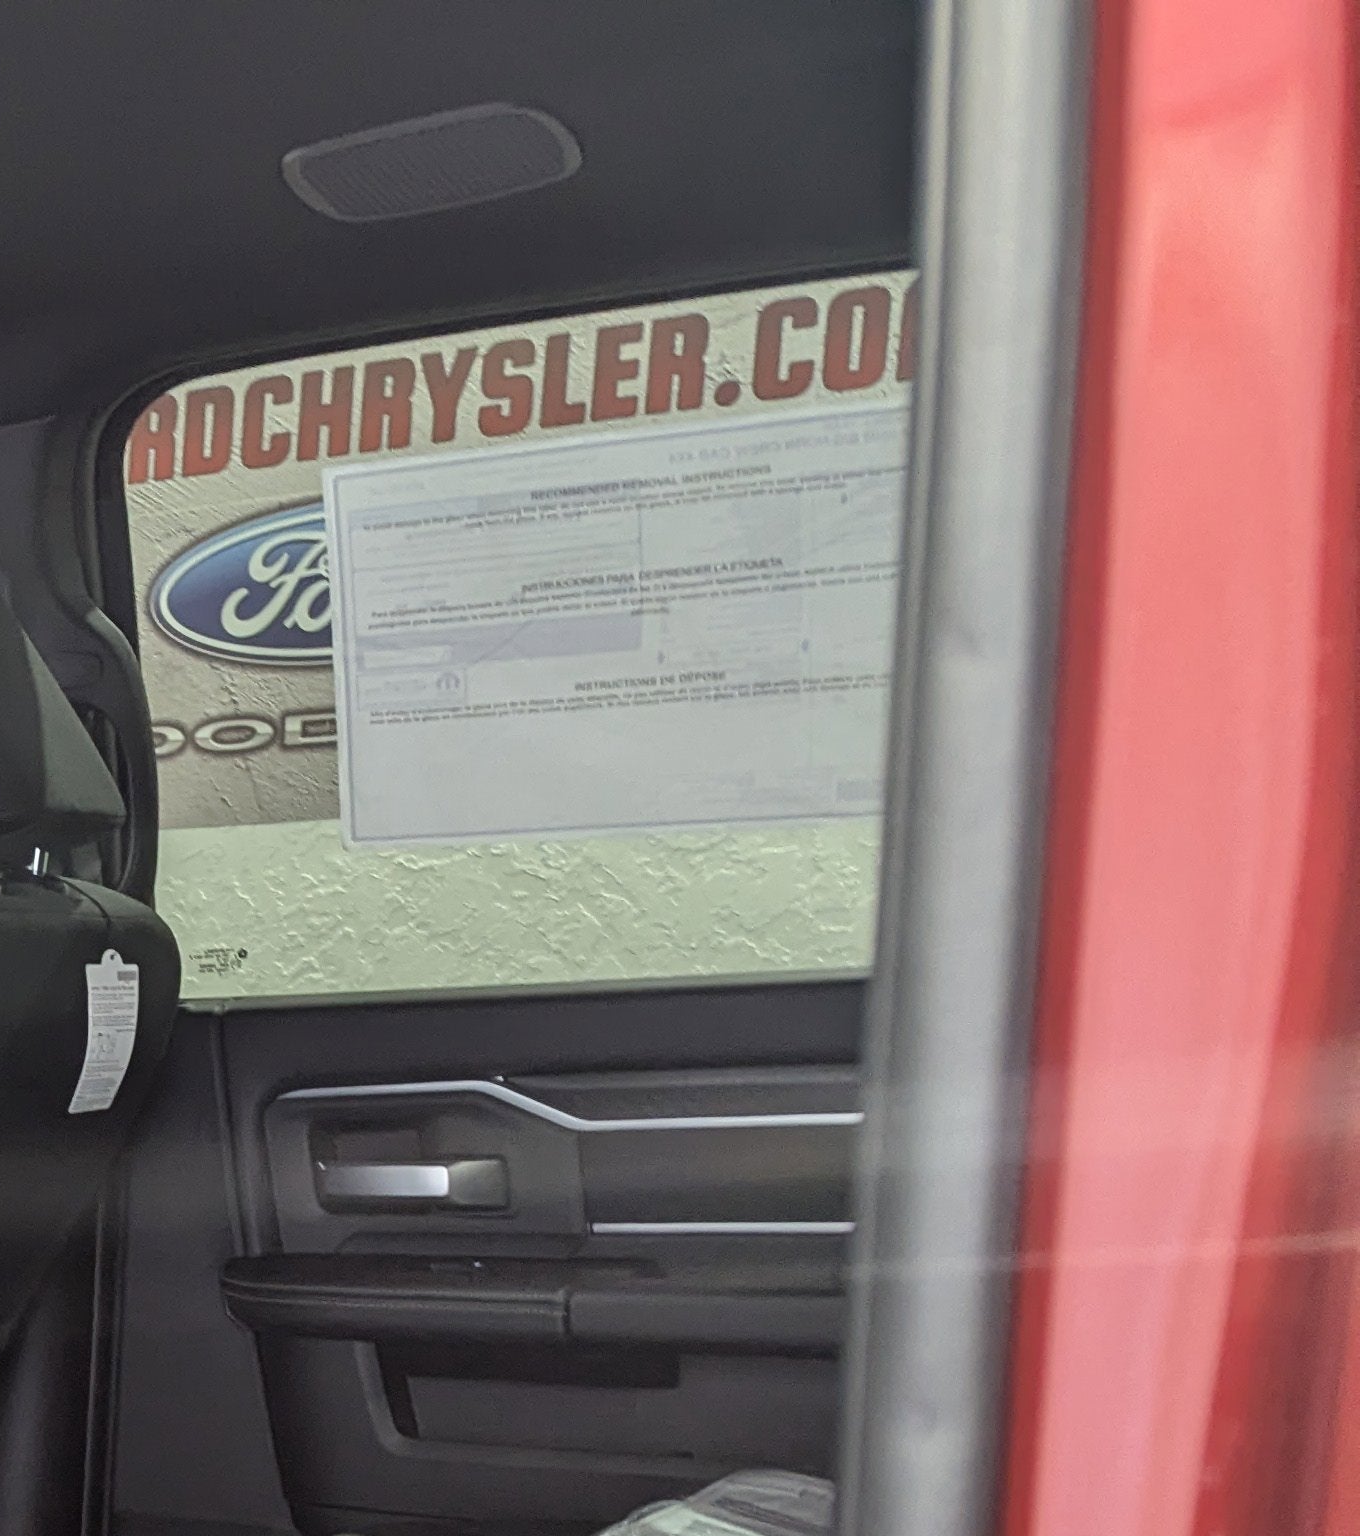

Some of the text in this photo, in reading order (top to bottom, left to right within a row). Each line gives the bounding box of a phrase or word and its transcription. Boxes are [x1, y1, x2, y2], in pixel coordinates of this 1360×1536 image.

[531, 480, 620, 500] RECOMMENDED
[622, 476, 677, 493] REMOVAL
[681, 464, 772, 485] INSTRUCTIONS
[575, 675, 657, 692] INSTRUCTIONS
